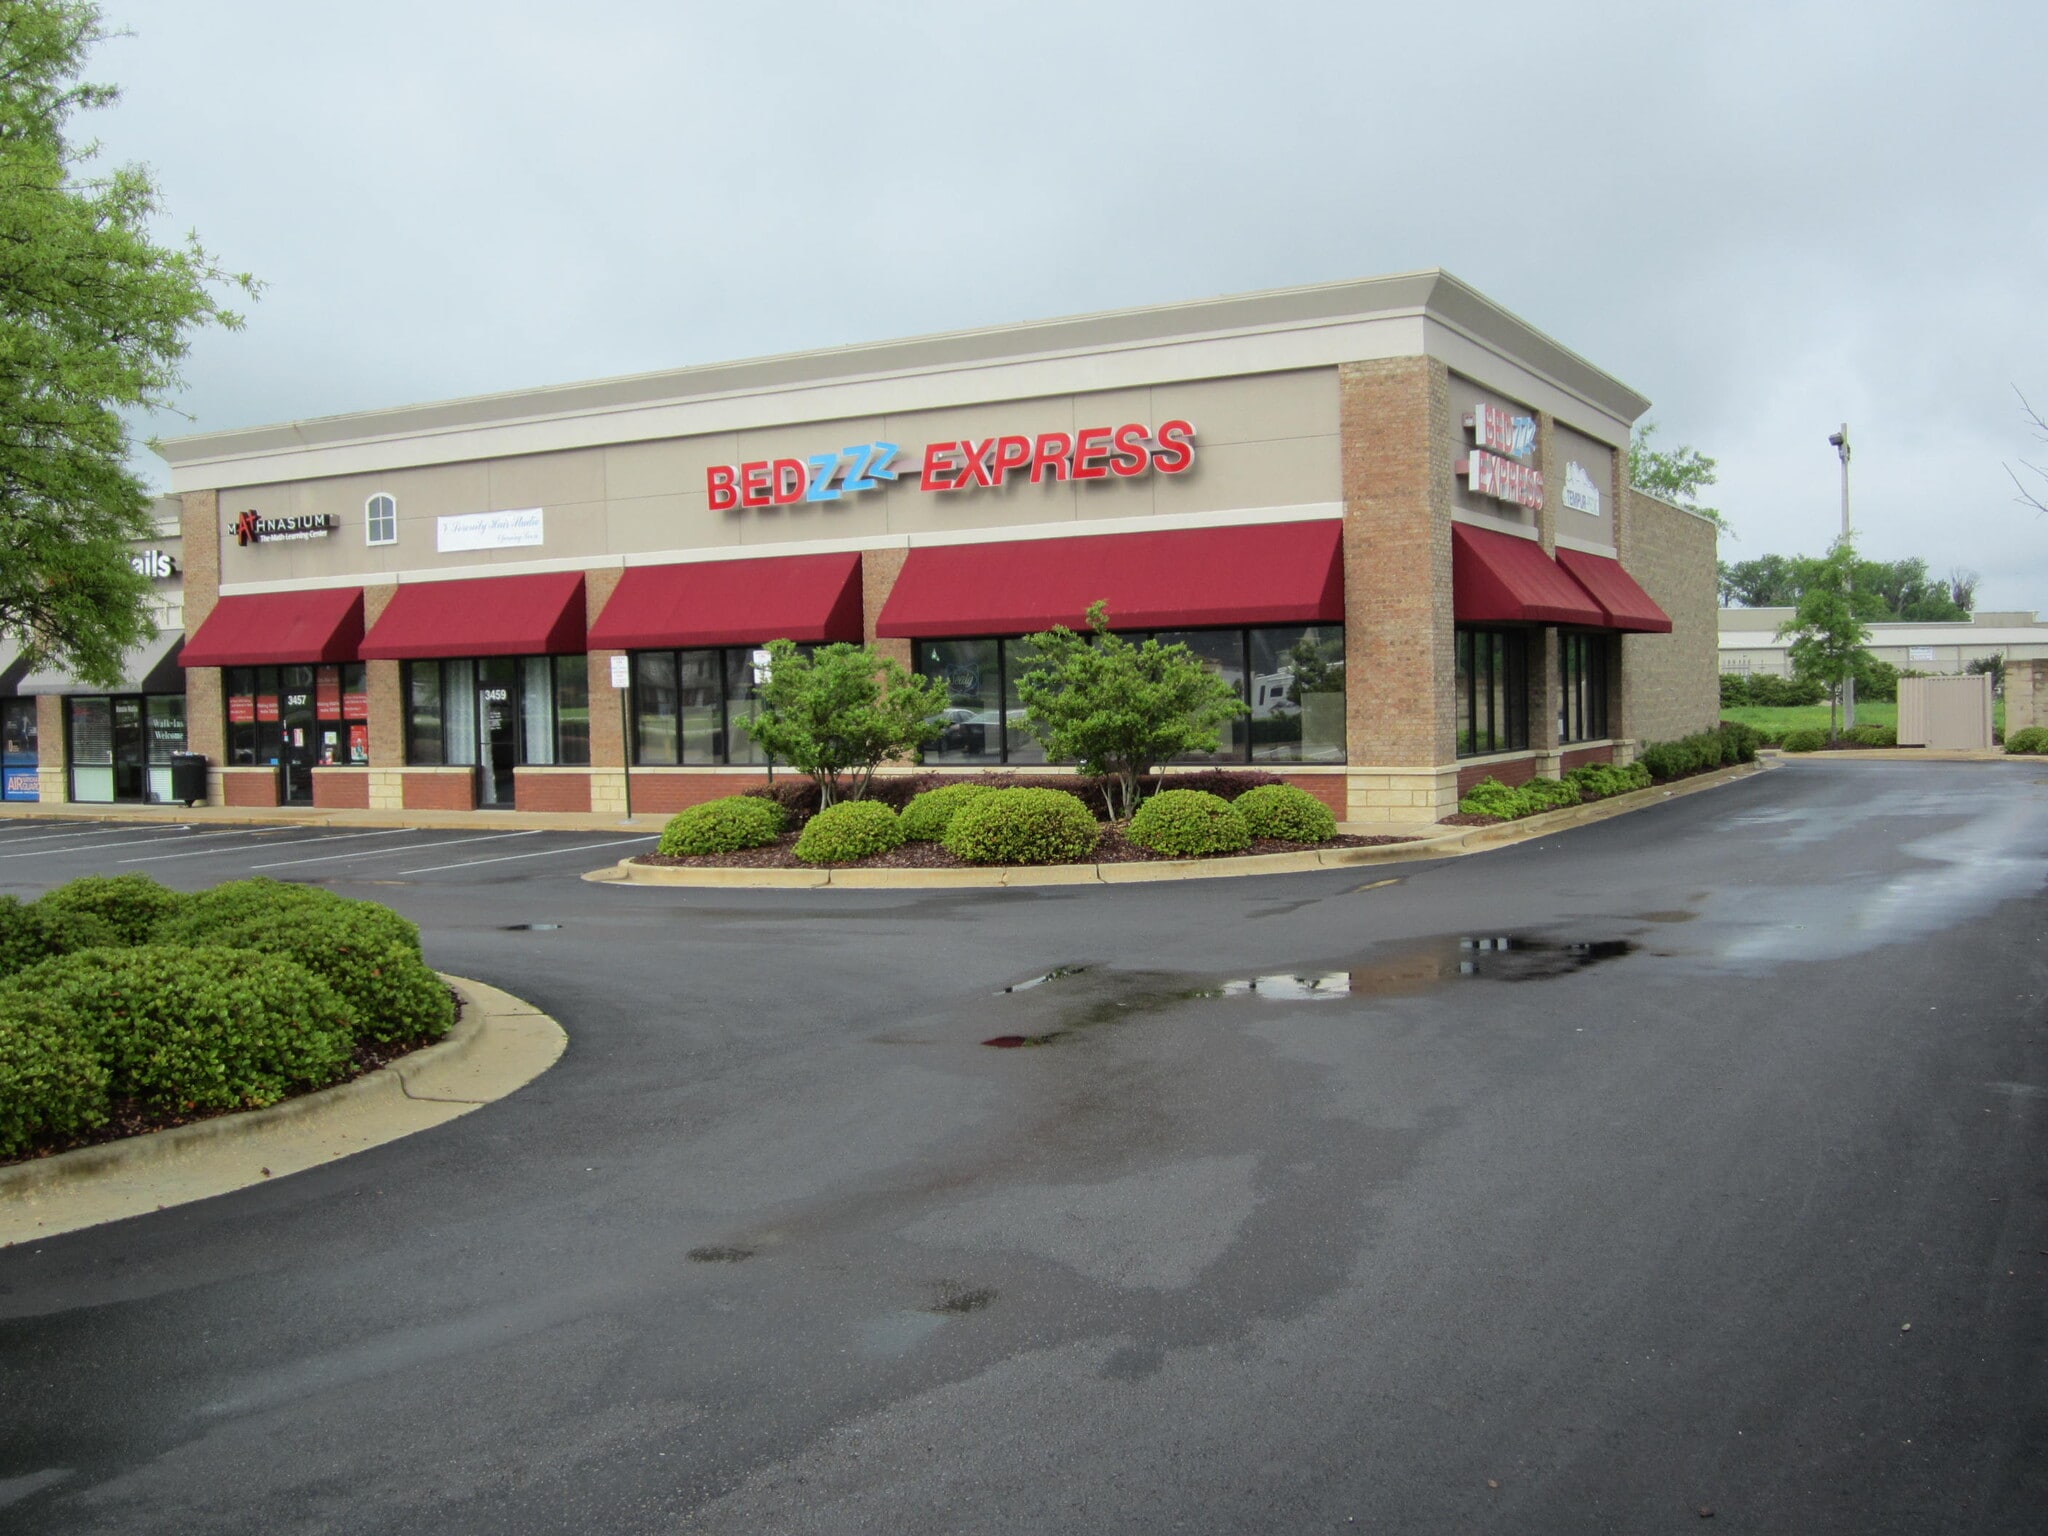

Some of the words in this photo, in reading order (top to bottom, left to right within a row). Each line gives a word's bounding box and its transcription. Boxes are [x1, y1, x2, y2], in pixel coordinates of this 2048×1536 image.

[920, 420, 1195, 491] EXPRESS
[1470, 449, 1544, 510] EXPRESS
[131, 549, 172, 578] ails
[287, 694, 308, 706] 3457
[484, 689, 507, 701] 3459
[154, 730, 184, 740] Welcome
